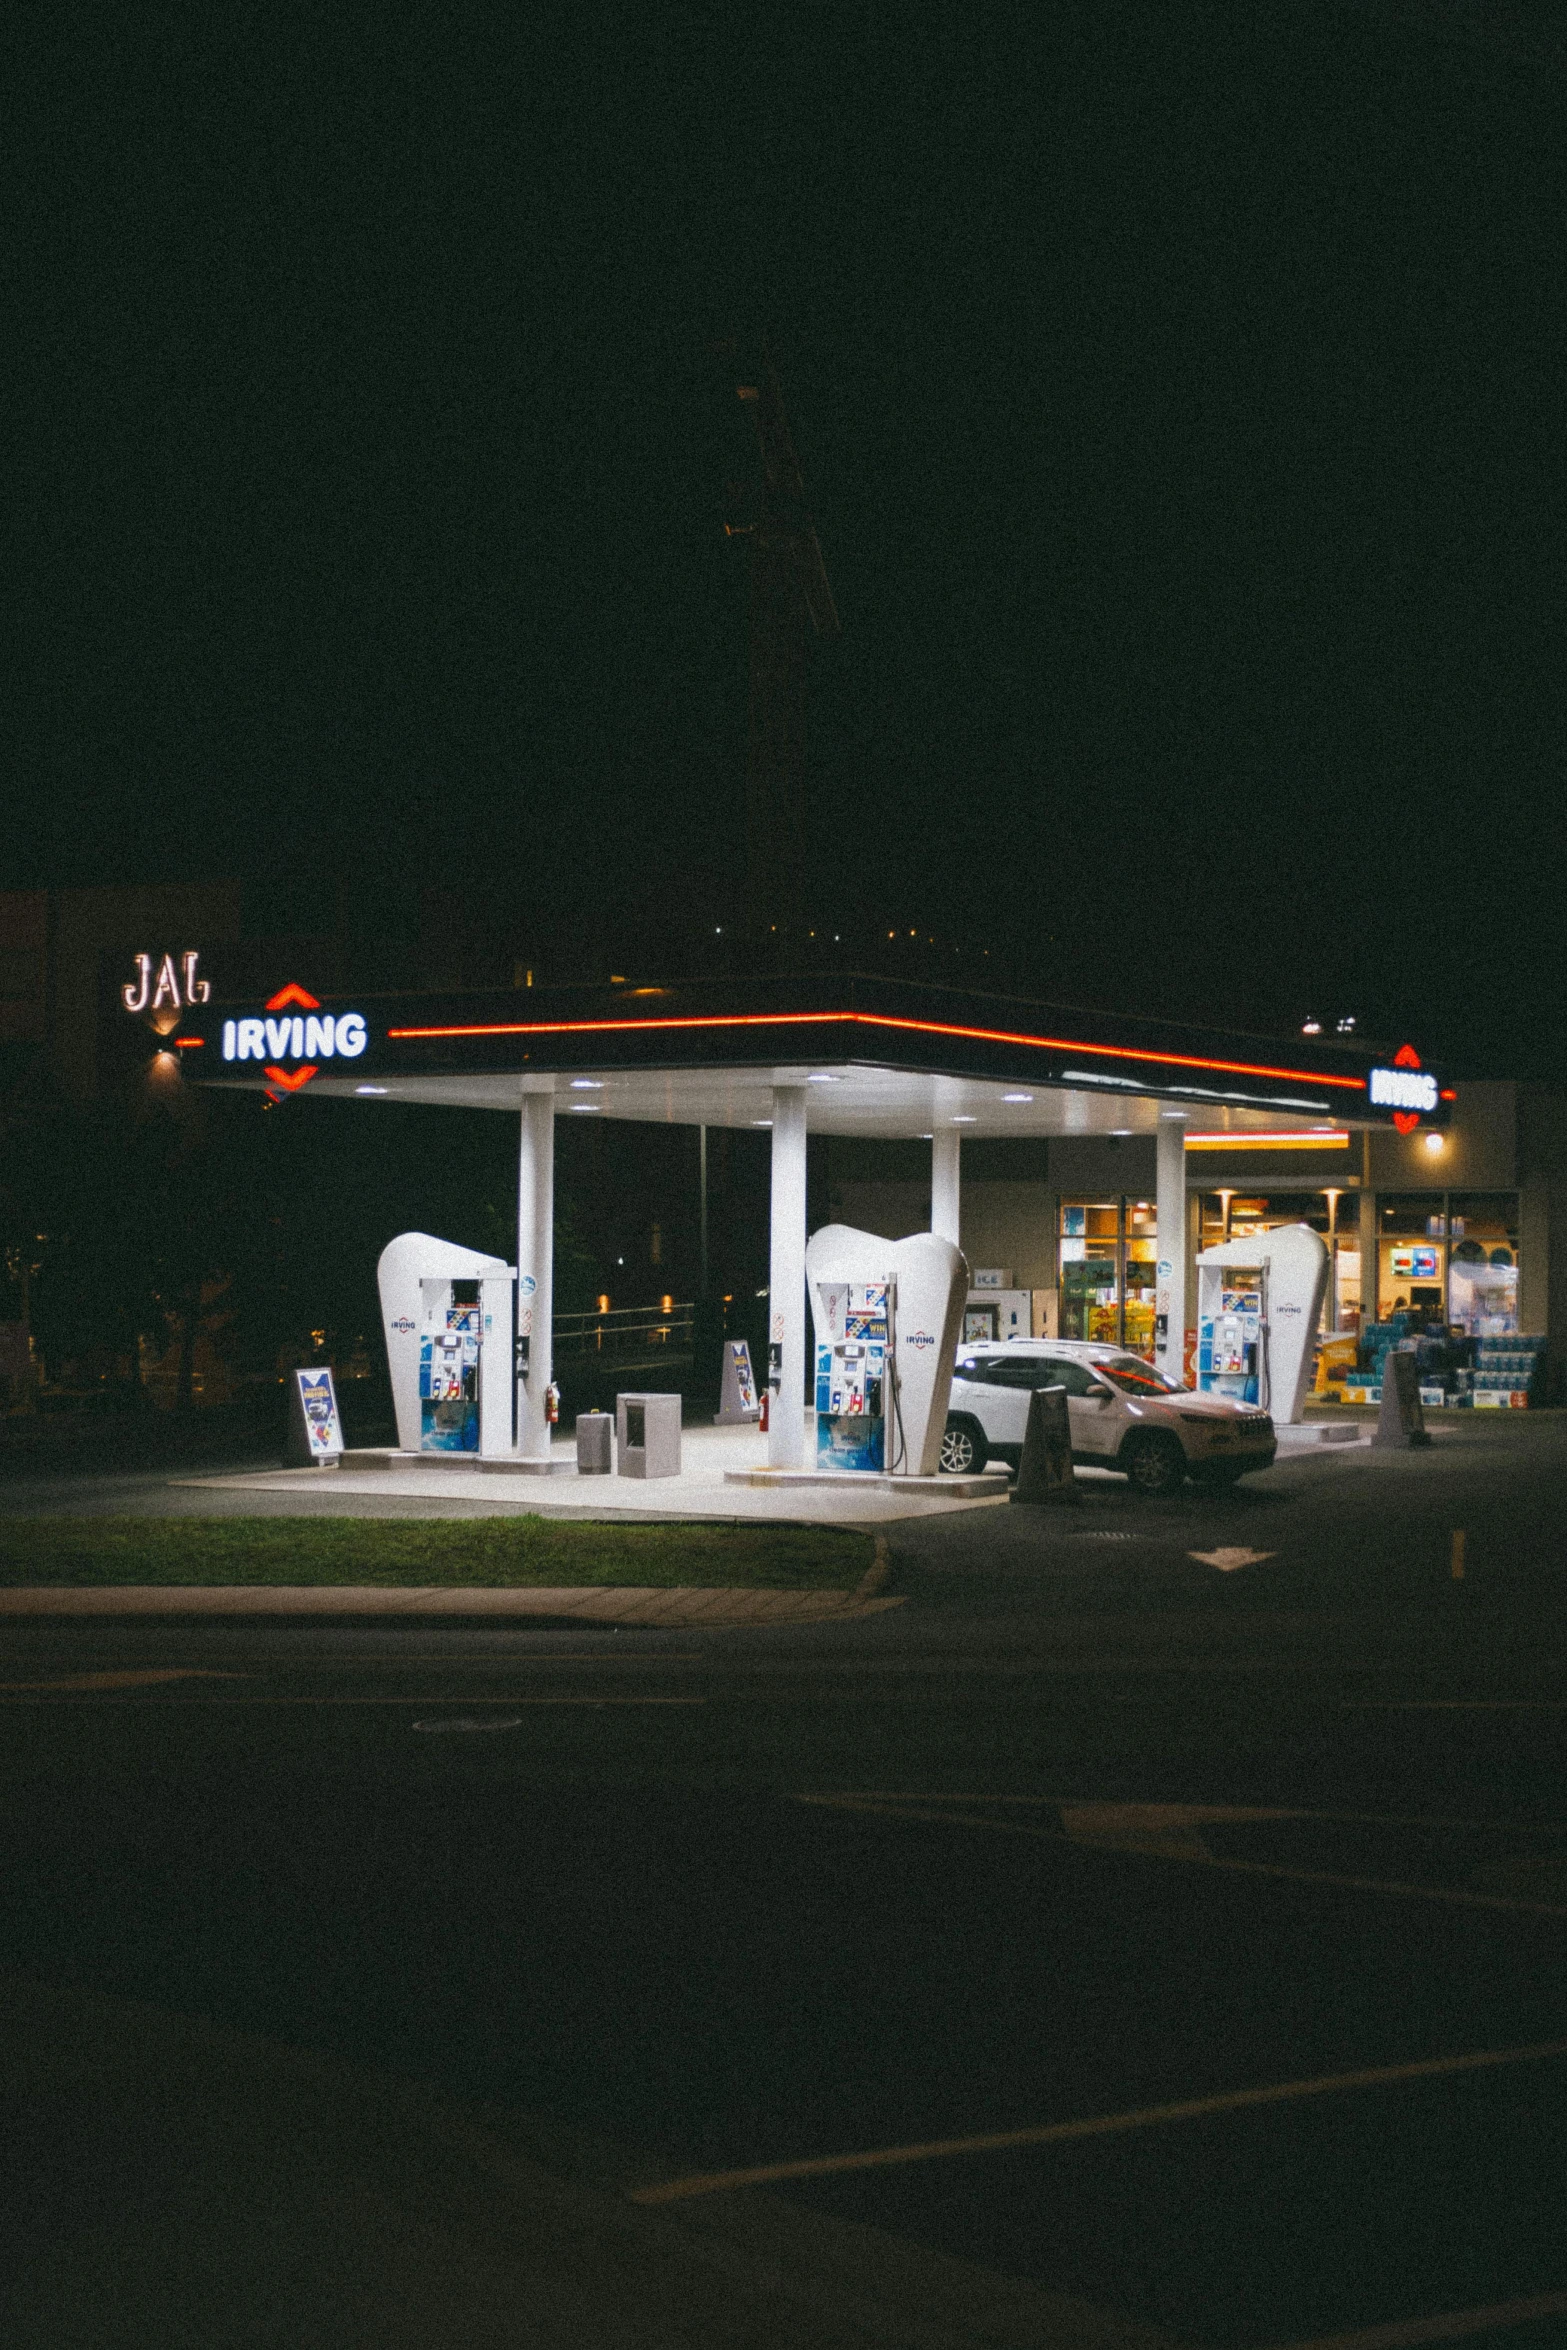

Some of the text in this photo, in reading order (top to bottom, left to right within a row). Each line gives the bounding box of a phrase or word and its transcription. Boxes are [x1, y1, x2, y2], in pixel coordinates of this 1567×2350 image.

[223, 1014, 366, 1060] IRVING
[977, 1275, 998, 1284] ICE
[869, 1323, 885, 1332] WIN
[906, 1336, 934, 1344] IRVING
